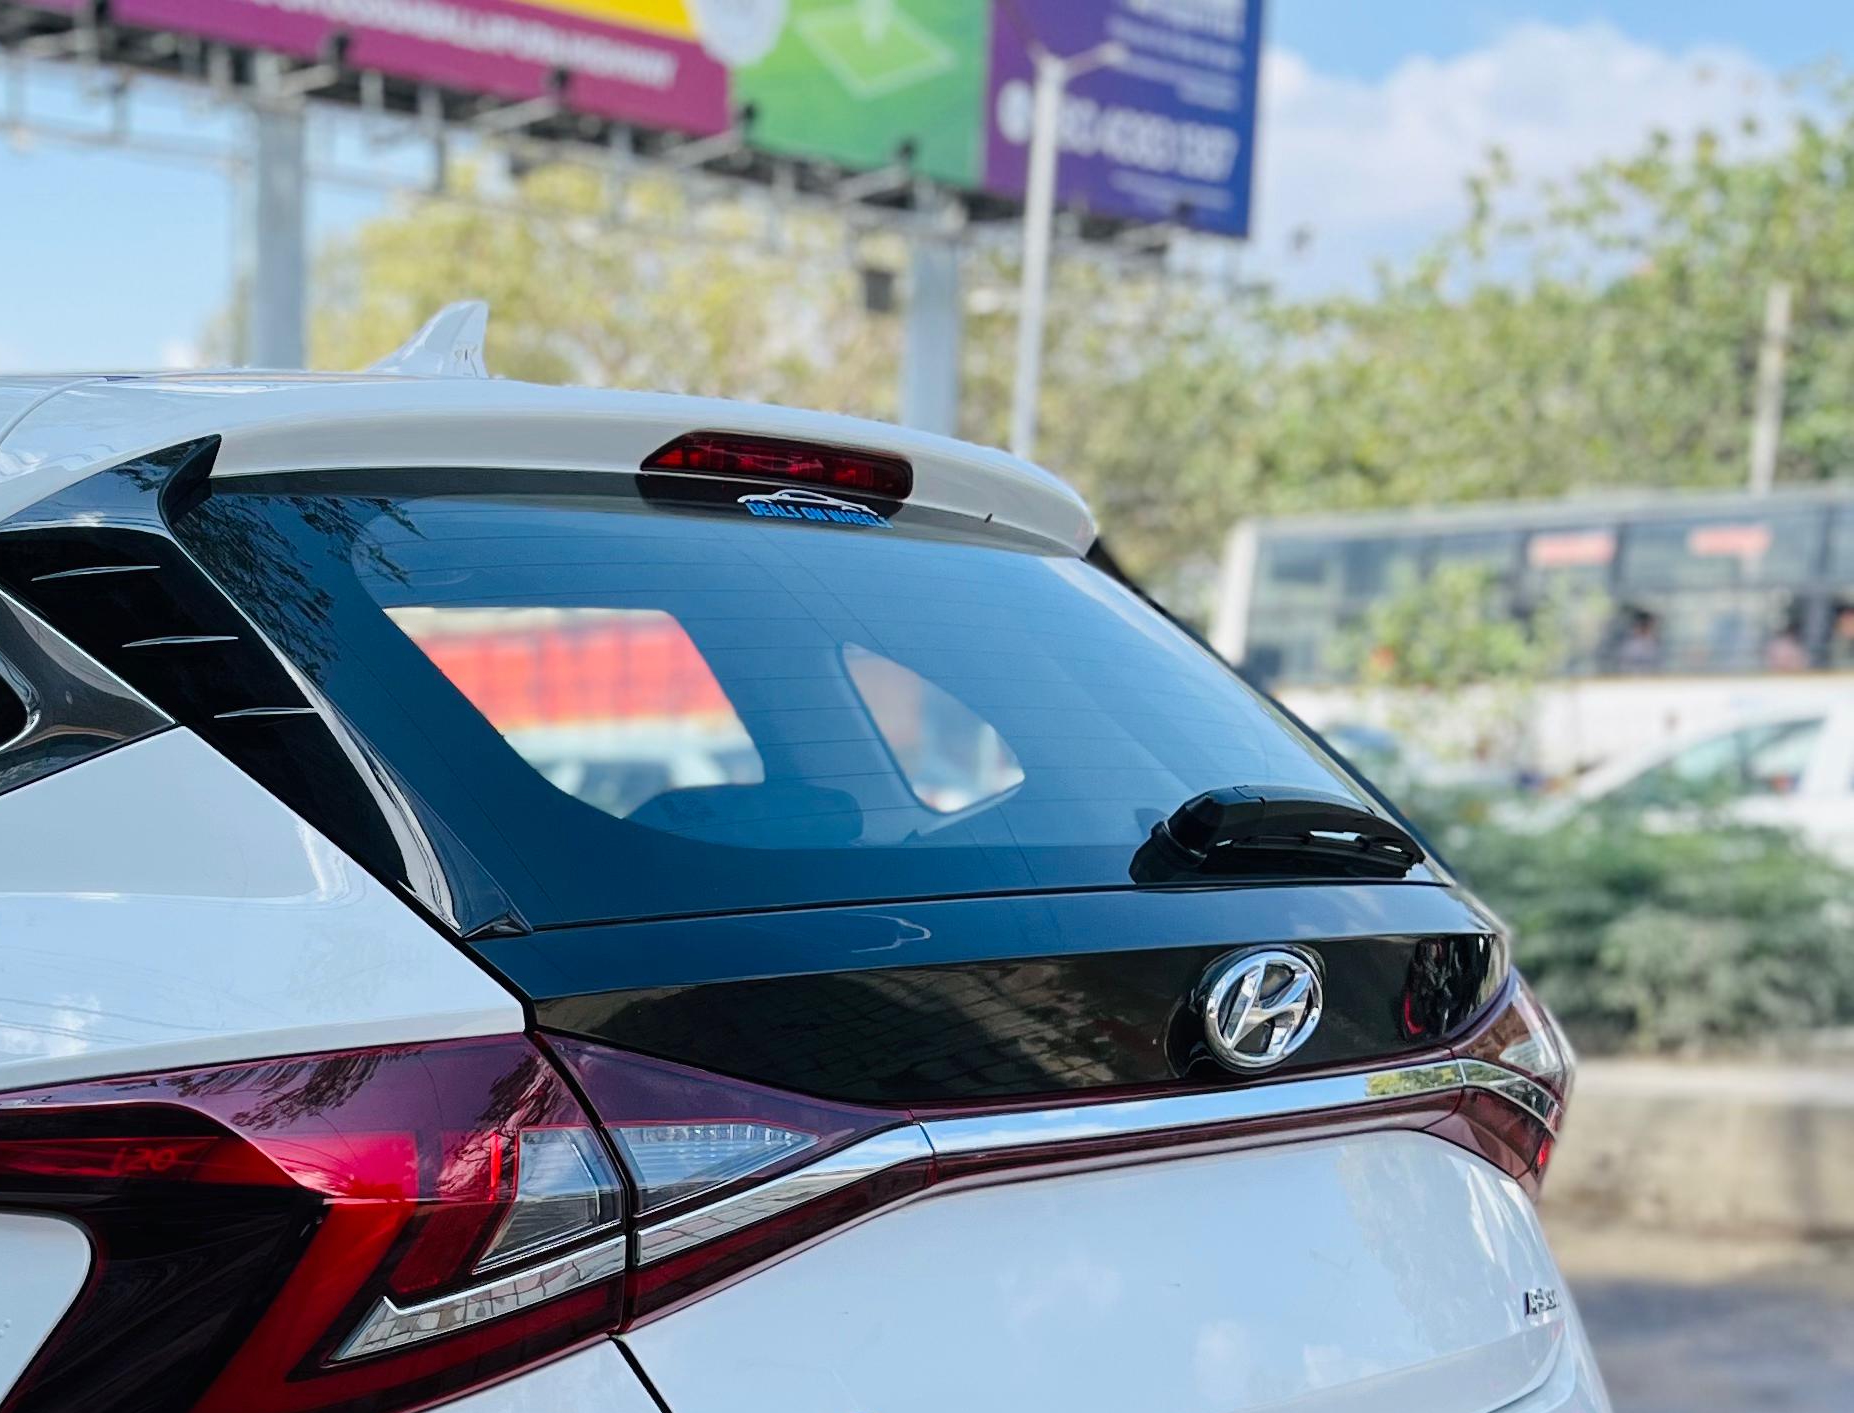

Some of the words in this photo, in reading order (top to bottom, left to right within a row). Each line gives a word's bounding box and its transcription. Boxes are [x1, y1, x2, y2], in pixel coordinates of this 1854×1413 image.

[746, 501, 802, 519] DEALS
[800, 506, 829, 521] ON
[823, 508, 894, 529] WHEELS
